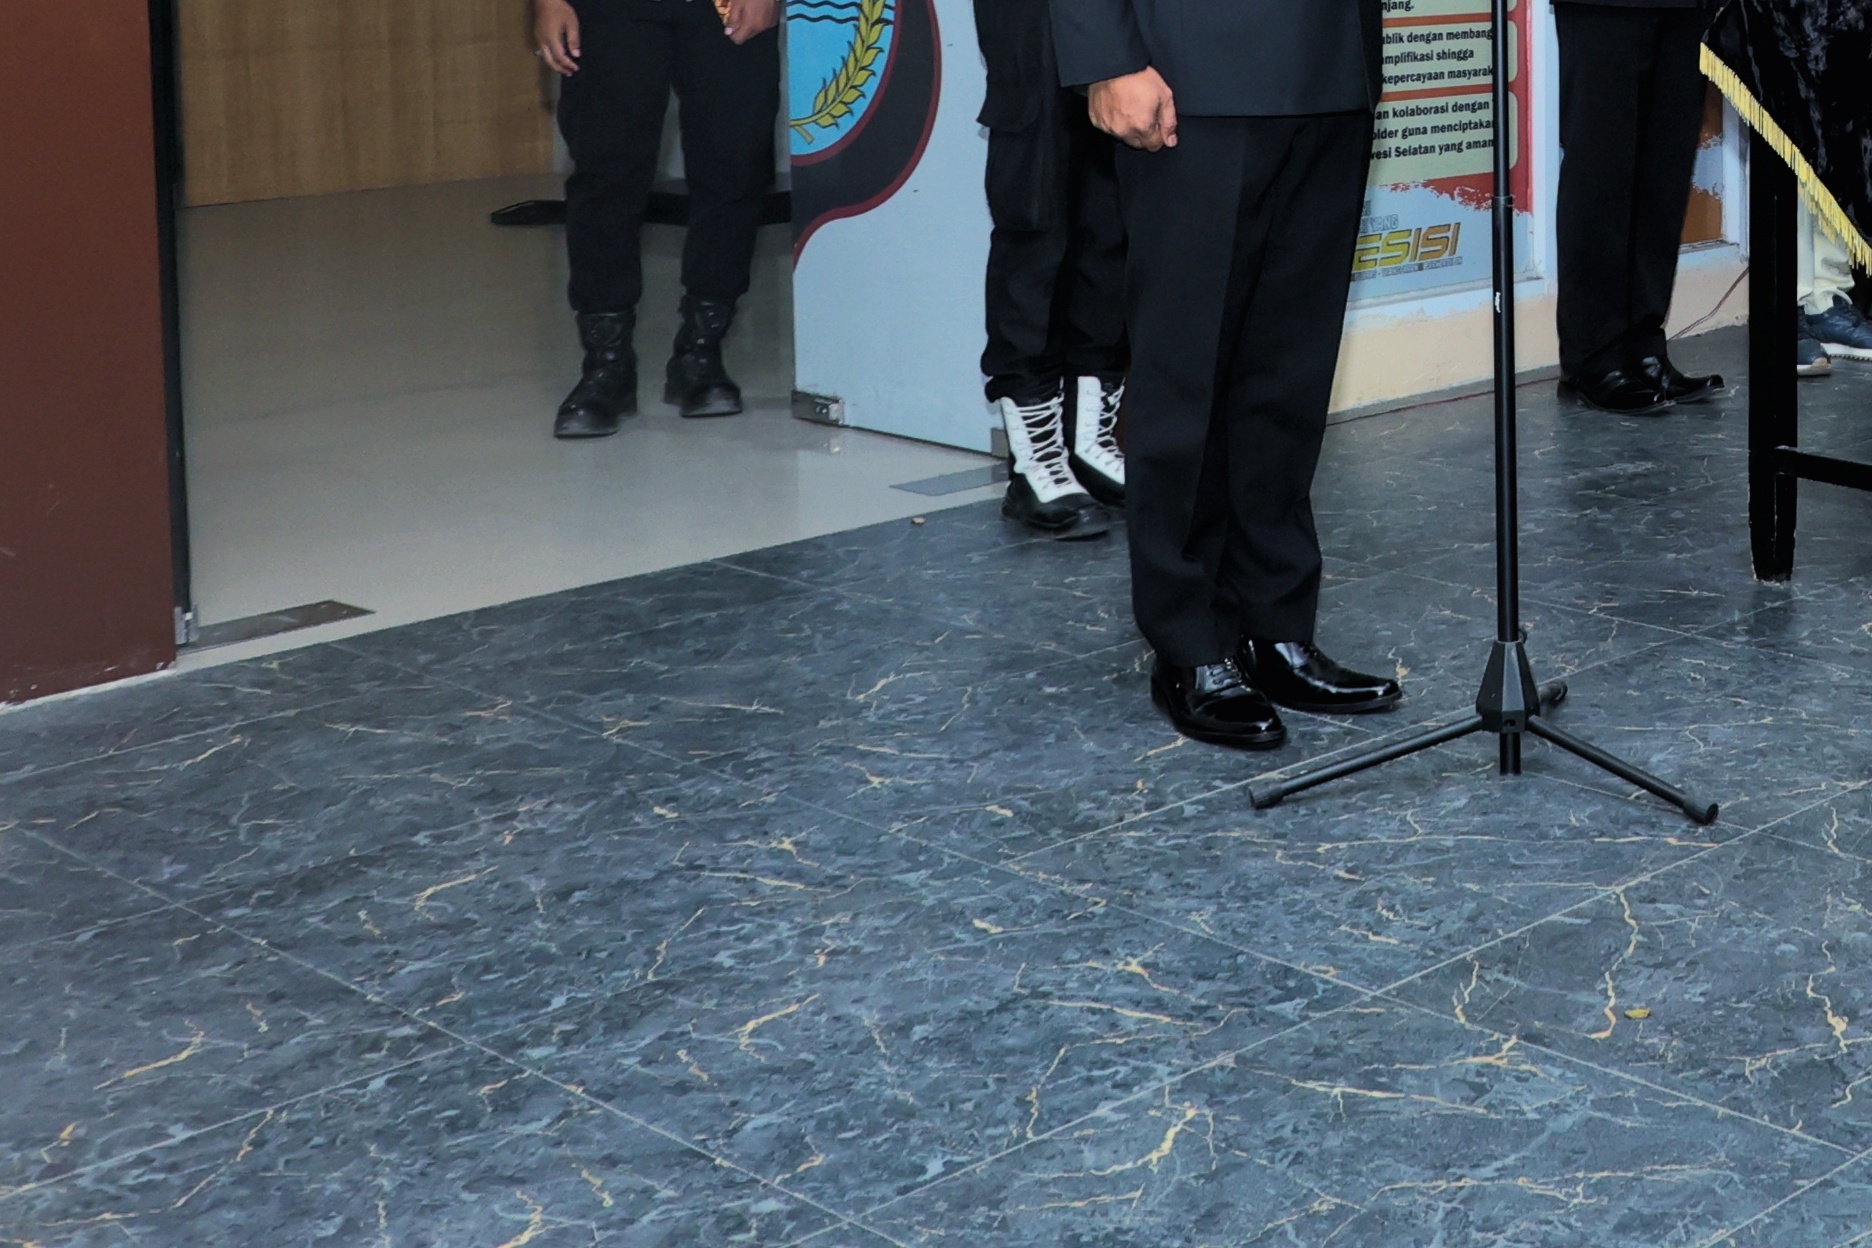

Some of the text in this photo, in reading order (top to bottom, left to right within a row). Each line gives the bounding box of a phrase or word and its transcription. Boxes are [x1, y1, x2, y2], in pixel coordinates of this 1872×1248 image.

[1407, 32, 1444, 44] dengan
[1436, 48, 1475, 61] shingga
[1392, 102, 1449, 118] kolaborasi
[1451, 100, 1490, 113] dengan
[1401, 126, 1428, 139] guna
[1394, 144, 1435, 157] Selatan
[1438, 140, 1464, 156] yang
[1352, 222, 1461, 271] ESISI
